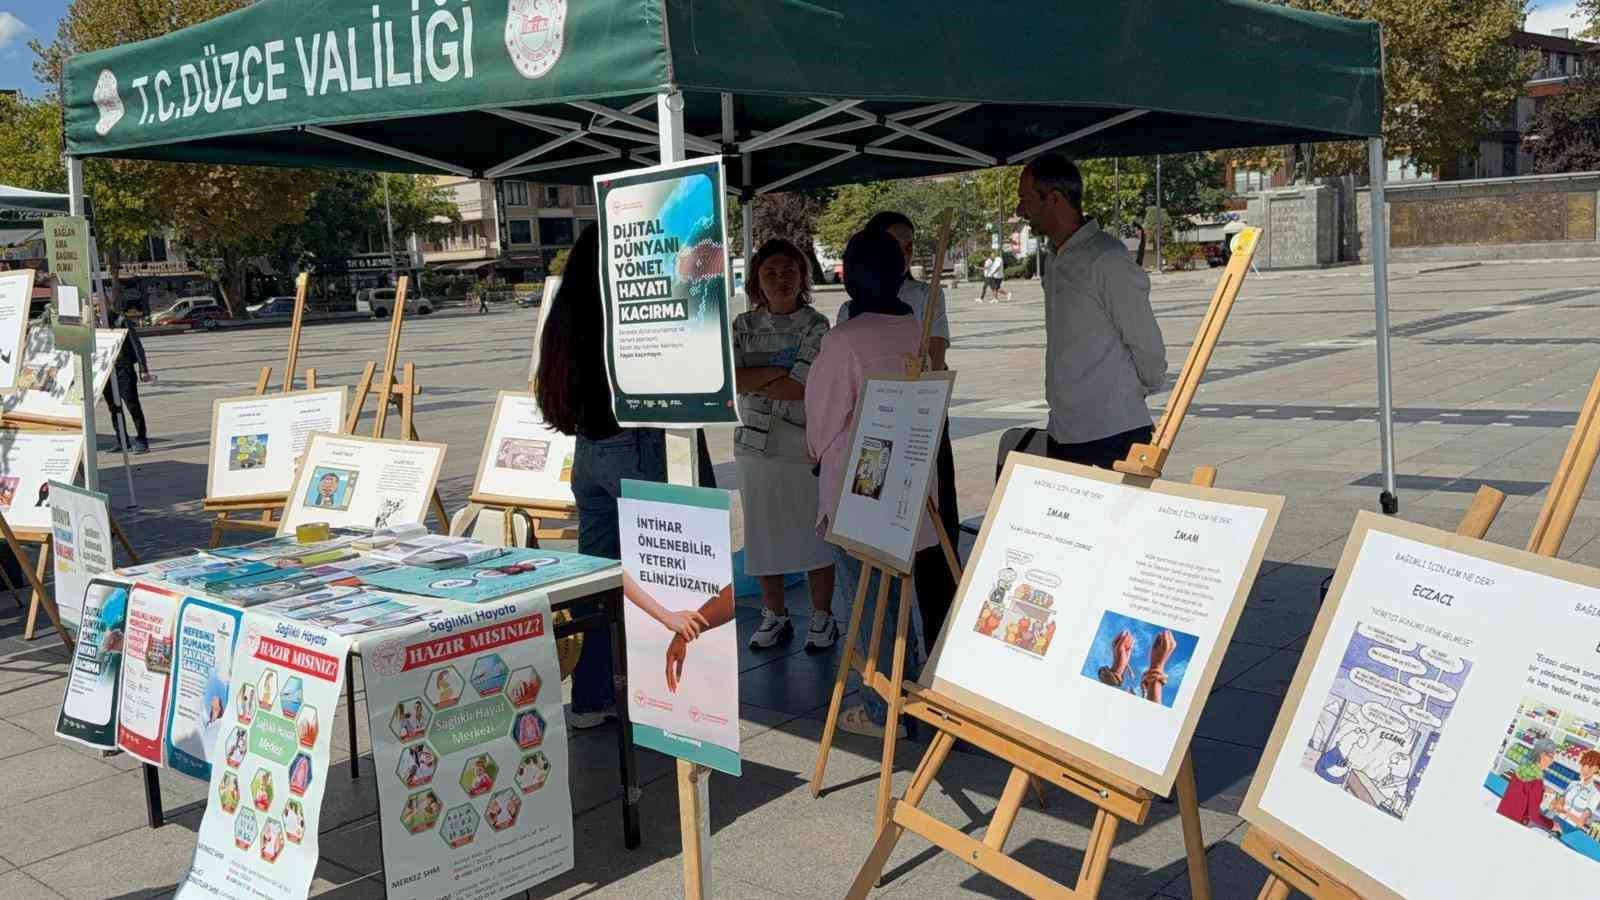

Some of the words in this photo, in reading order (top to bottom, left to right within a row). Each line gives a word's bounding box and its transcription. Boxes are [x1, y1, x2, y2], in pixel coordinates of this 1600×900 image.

[613, 218, 664, 239] DİJİTAL
[614, 237, 679, 259] DÜNYANI
[618, 280, 668, 299] HAYATI
[637, 514, 682, 533] İNTİHAR
[638, 533, 715, 559] ÖNLENEBİLİR,
[639, 553, 686, 571] YETERKİ
[1412, 584, 1454, 606] ECZACI
[429, 615, 473, 634] Sağlıklı
[475, 603, 517, 623] Hayata
[410, 638, 465, 664] HAZIR
[470, 618, 540, 649] MISINIZ?
[260, 642, 290, 664] HAZIR
